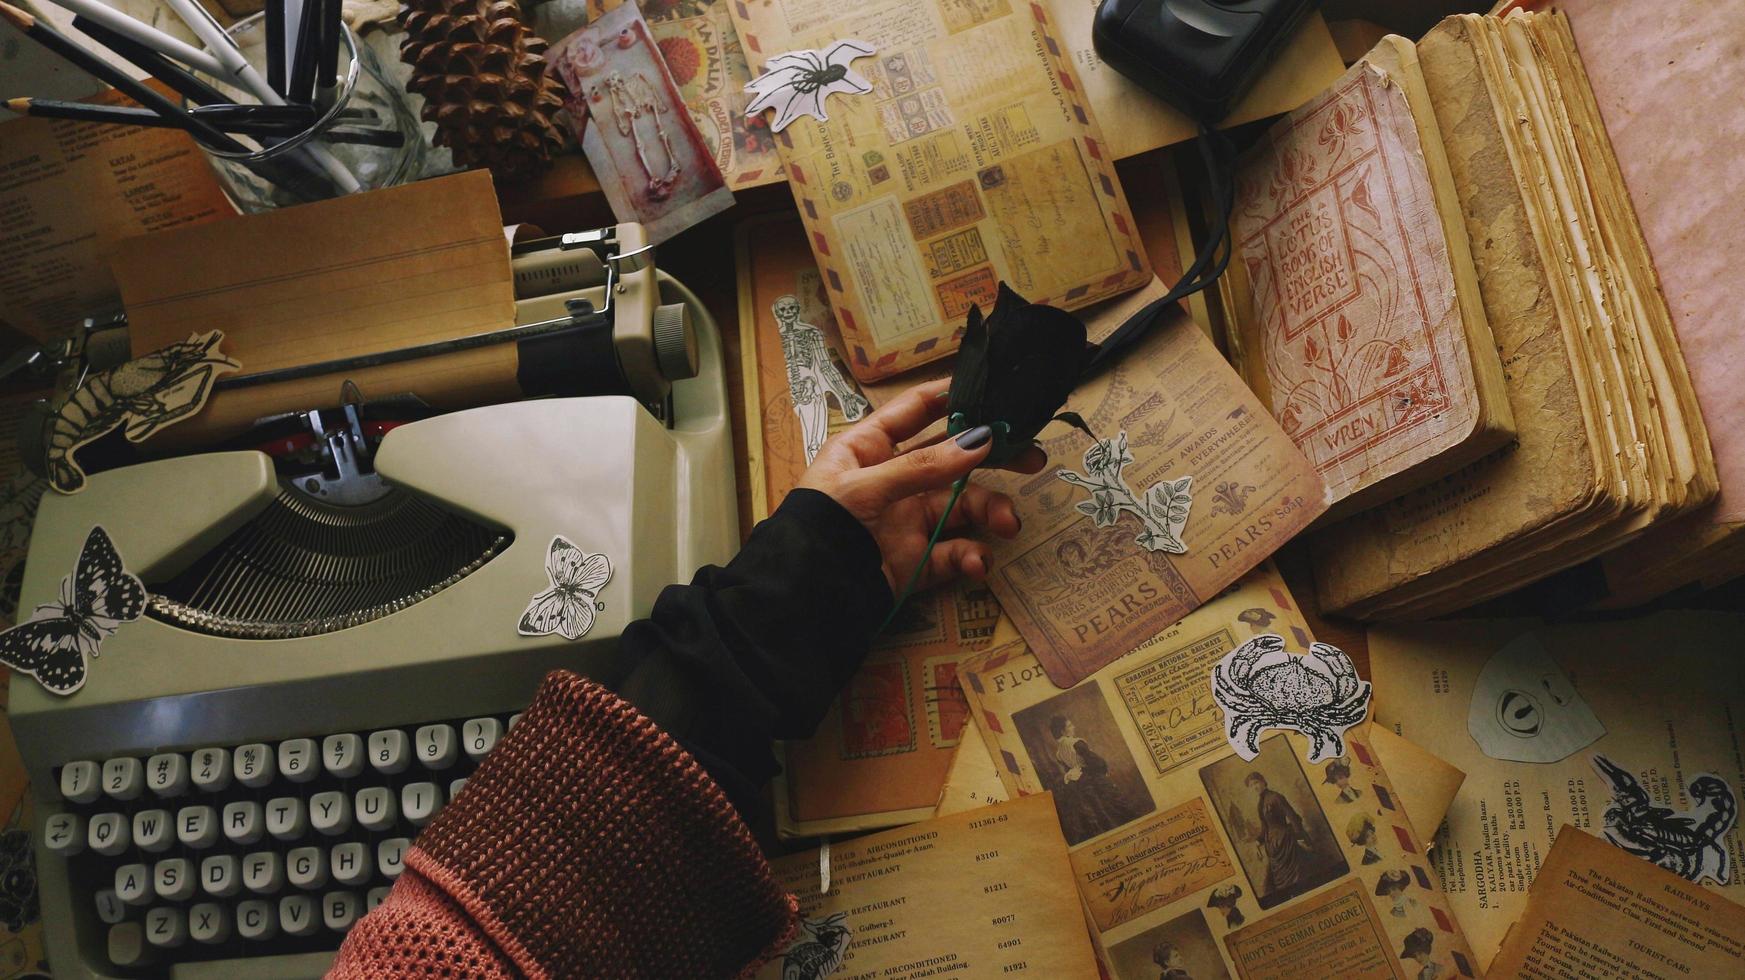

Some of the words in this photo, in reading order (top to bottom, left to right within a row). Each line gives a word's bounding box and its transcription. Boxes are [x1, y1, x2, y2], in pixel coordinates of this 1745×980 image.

[704, 43, 721, 93] DALIA
[709, 101, 730, 134] GOLDEN
[821, 134, 834, 159] BANK
[829, 160, 840, 177] THE
[1290, 209, 1313, 229] THE
[1279, 214, 1333, 258] LOTUS
[1282, 242, 1317, 279] BOOK
[1319, 228, 1335, 254] OF
[1287, 254, 1343, 299] ENGLISH
[1290, 273, 1348, 316] VERSE
[1324, 416, 1374, 450] WREN
[1134, 458, 1177, 489] HIGHEST
[1176, 426, 1219, 459] AWARDS
[1274, 494, 1307, 521] Soap
[1055, 599, 1086, 623] PARIS
[1087, 564, 1143, 603] EXHIBITION
[1072, 578, 1159, 645] PEARS
[1125, 665, 1156, 684] CANADIAN
[1158, 651, 1188, 669] NATIONAL
[1190, 636, 1221, 654] RAILWAYS
[1143, 671, 1167, 686] COACH
[1208, 646, 1224, 656] WAY
[1141, 720, 1169, 764] 367430
[1503, 779, 1511, 795] P.D.
[1513, 778, 1521, 795] P.D.
[1567, 777, 1575, 793] P.D.
[1576, 776, 1584, 793] P.D.
[96, 821, 111, 843] Q
[141, 818, 157, 837] W
[185, 815, 200, 833] E
[232, 810, 247, 829] R
[275, 806, 289, 824] T
[319, 800, 333, 819] Y
[365, 796, 379, 815] U
[416, 792, 421, 810] I
[969, 814, 1008, 830] 311361-63
[1478, 797, 1487, 821] Bazar.
[1489, 813, 1498, 835] baths.
[865, 830, 939, 855] AIRCONDITIONED
[1481, 822, 1491, 850] Muslim
[1492, 837, 1500, 854] with
[1501, 830, 1512, 859] facility.
[124, 873, 136, 891] A
[162, 867, 177, 886] S
[210, 865, 225, 883] D
[252, 861, 267, 880] F
[296, 856, 310, 875] G
[340, 851, 354, 871] H
[387, 847, 401, 866] J
[976, 850, 999, 863] 83101
[1085, 858, 1125, 881] Travelers
[1125, 839, 1166, 863] Insurance
[1445, 848, 1455, 876] address
[1455, 849, 1466, 892] Telephones
[1485, 851, 1496, 892] KALYAR,
[1495, 856, 1504, 879] rooms
[1505, 861, 1514, 878] park
[1513, 846, 1521, 866] room
[845, 864, 902, 883] RESTAURANT
[1473, 849, 1488, 909] SARGODHA
[1498, 882, 1506, 892] 20
[1515, 868, 1525, 891] Single
[850, 896, 907, 915] RESTAURANT
[983, 882, 1008, 894] 81211
[1586, 868, 1603, 881] The
[1603, 876, 1635, 897] Pakistan
[1634, 891, 1670, 915] Railways
[1662, 883, 1711, 912] RAILWAYS
[155, 916, 169, 934] Z
[198, 912, 212, 930] X
[245, 908, 260, 928] C
[289, 903, 303, 923] V
[332, 900, 346, 919] B
[1562, 877, 1622, 911] Air-Conditioned
[1644, 917, 1662, 930] First
[1661, 925, 1678, 938] and
[1567, 869, 1589, 885] Three
[1591, 881, 1616, 898] classes
[1618, 894, 1629, 904] of
[1629, 899, 1689, 934] accommodation
[1691, 930, 1704, 940] are
[1706, 936, 1742, 960] provided
[849, 930, 907, 950] RESTAURANT
[991, 914, 1016, 925] 80077
[997, 938, 1022, 950] 64901
[1241, 942, 1275, 964] HOYT'S
[1277, 924, 1316, 949] GERMAN
[1543, 919, 1560, 932] The
[1559, 927, 1592, 948] Pakistan
[1590, 942, 1626, 966] Railways
[882, 953, 957, 976] AIRCONDITIONED
[1003, 962, 1027, 973] 81921
[1525, 952, 1542, 966] and
[1542, 961, 1556, 972] are
[1529, 944, 1546, 957] bed
[1547, 953, 1575, 972] rooms,
[1534, 936, 1563, 955] Tourist
[1562, 950, 1581, 964] Cars
[1580, 959, 1596, 971] and
[1539, 928, 1561, 944] These
[1562, 940, 1577, 951] can
[1577, 947, 1589, 957] be
[1589, 952, 1620, 972] reserved
[1620, 968, 1630, 977] at
[1626, 938, 1666, 963] TOURIST
[1665, 957, 1691, 975] CARS
[908, 967, 936, 979] Alfalah
[936, 959, 970, 974] Building.
